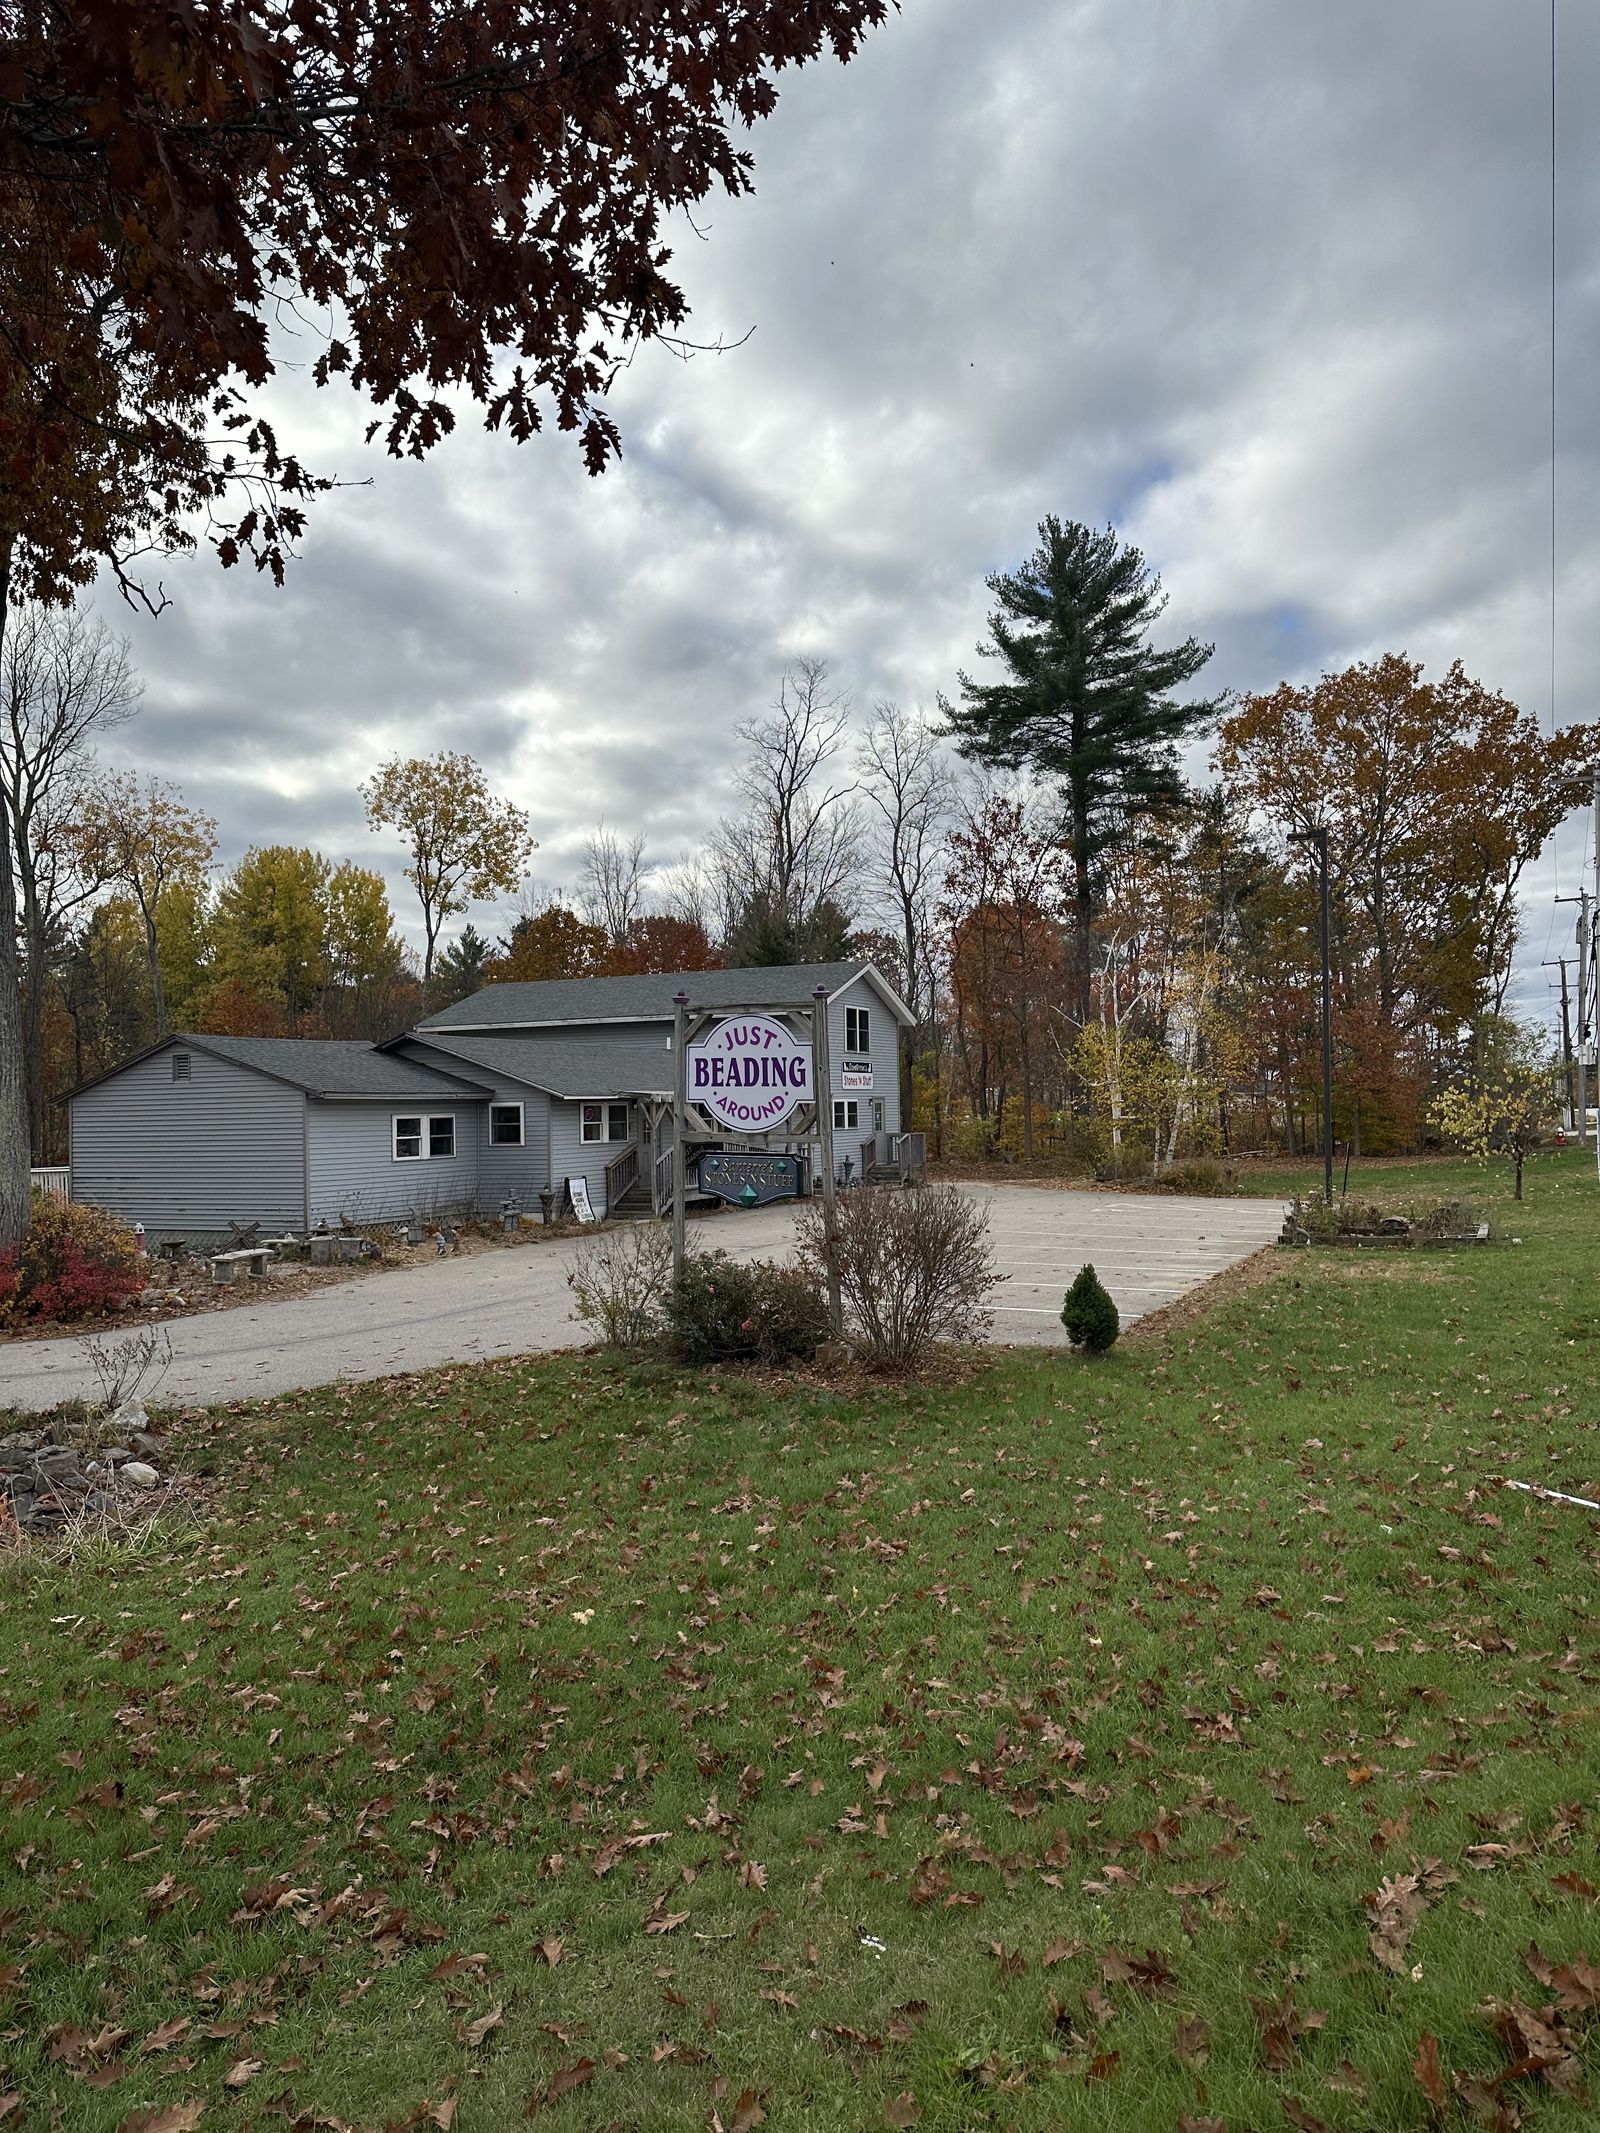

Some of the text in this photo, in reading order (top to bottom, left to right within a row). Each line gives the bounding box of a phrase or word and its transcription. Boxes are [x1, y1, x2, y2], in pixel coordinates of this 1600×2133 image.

[724, 1025, 778, 1051] JUST
[694, 1056, 806, 1088] BEADING
[716, 1095, 785, 1121] AROUND
[722, 1158, 774, 1172] Santerre's
[704, 1170, 745, 1188] STONES
[759, 1172, 794, 1190] STUFF
